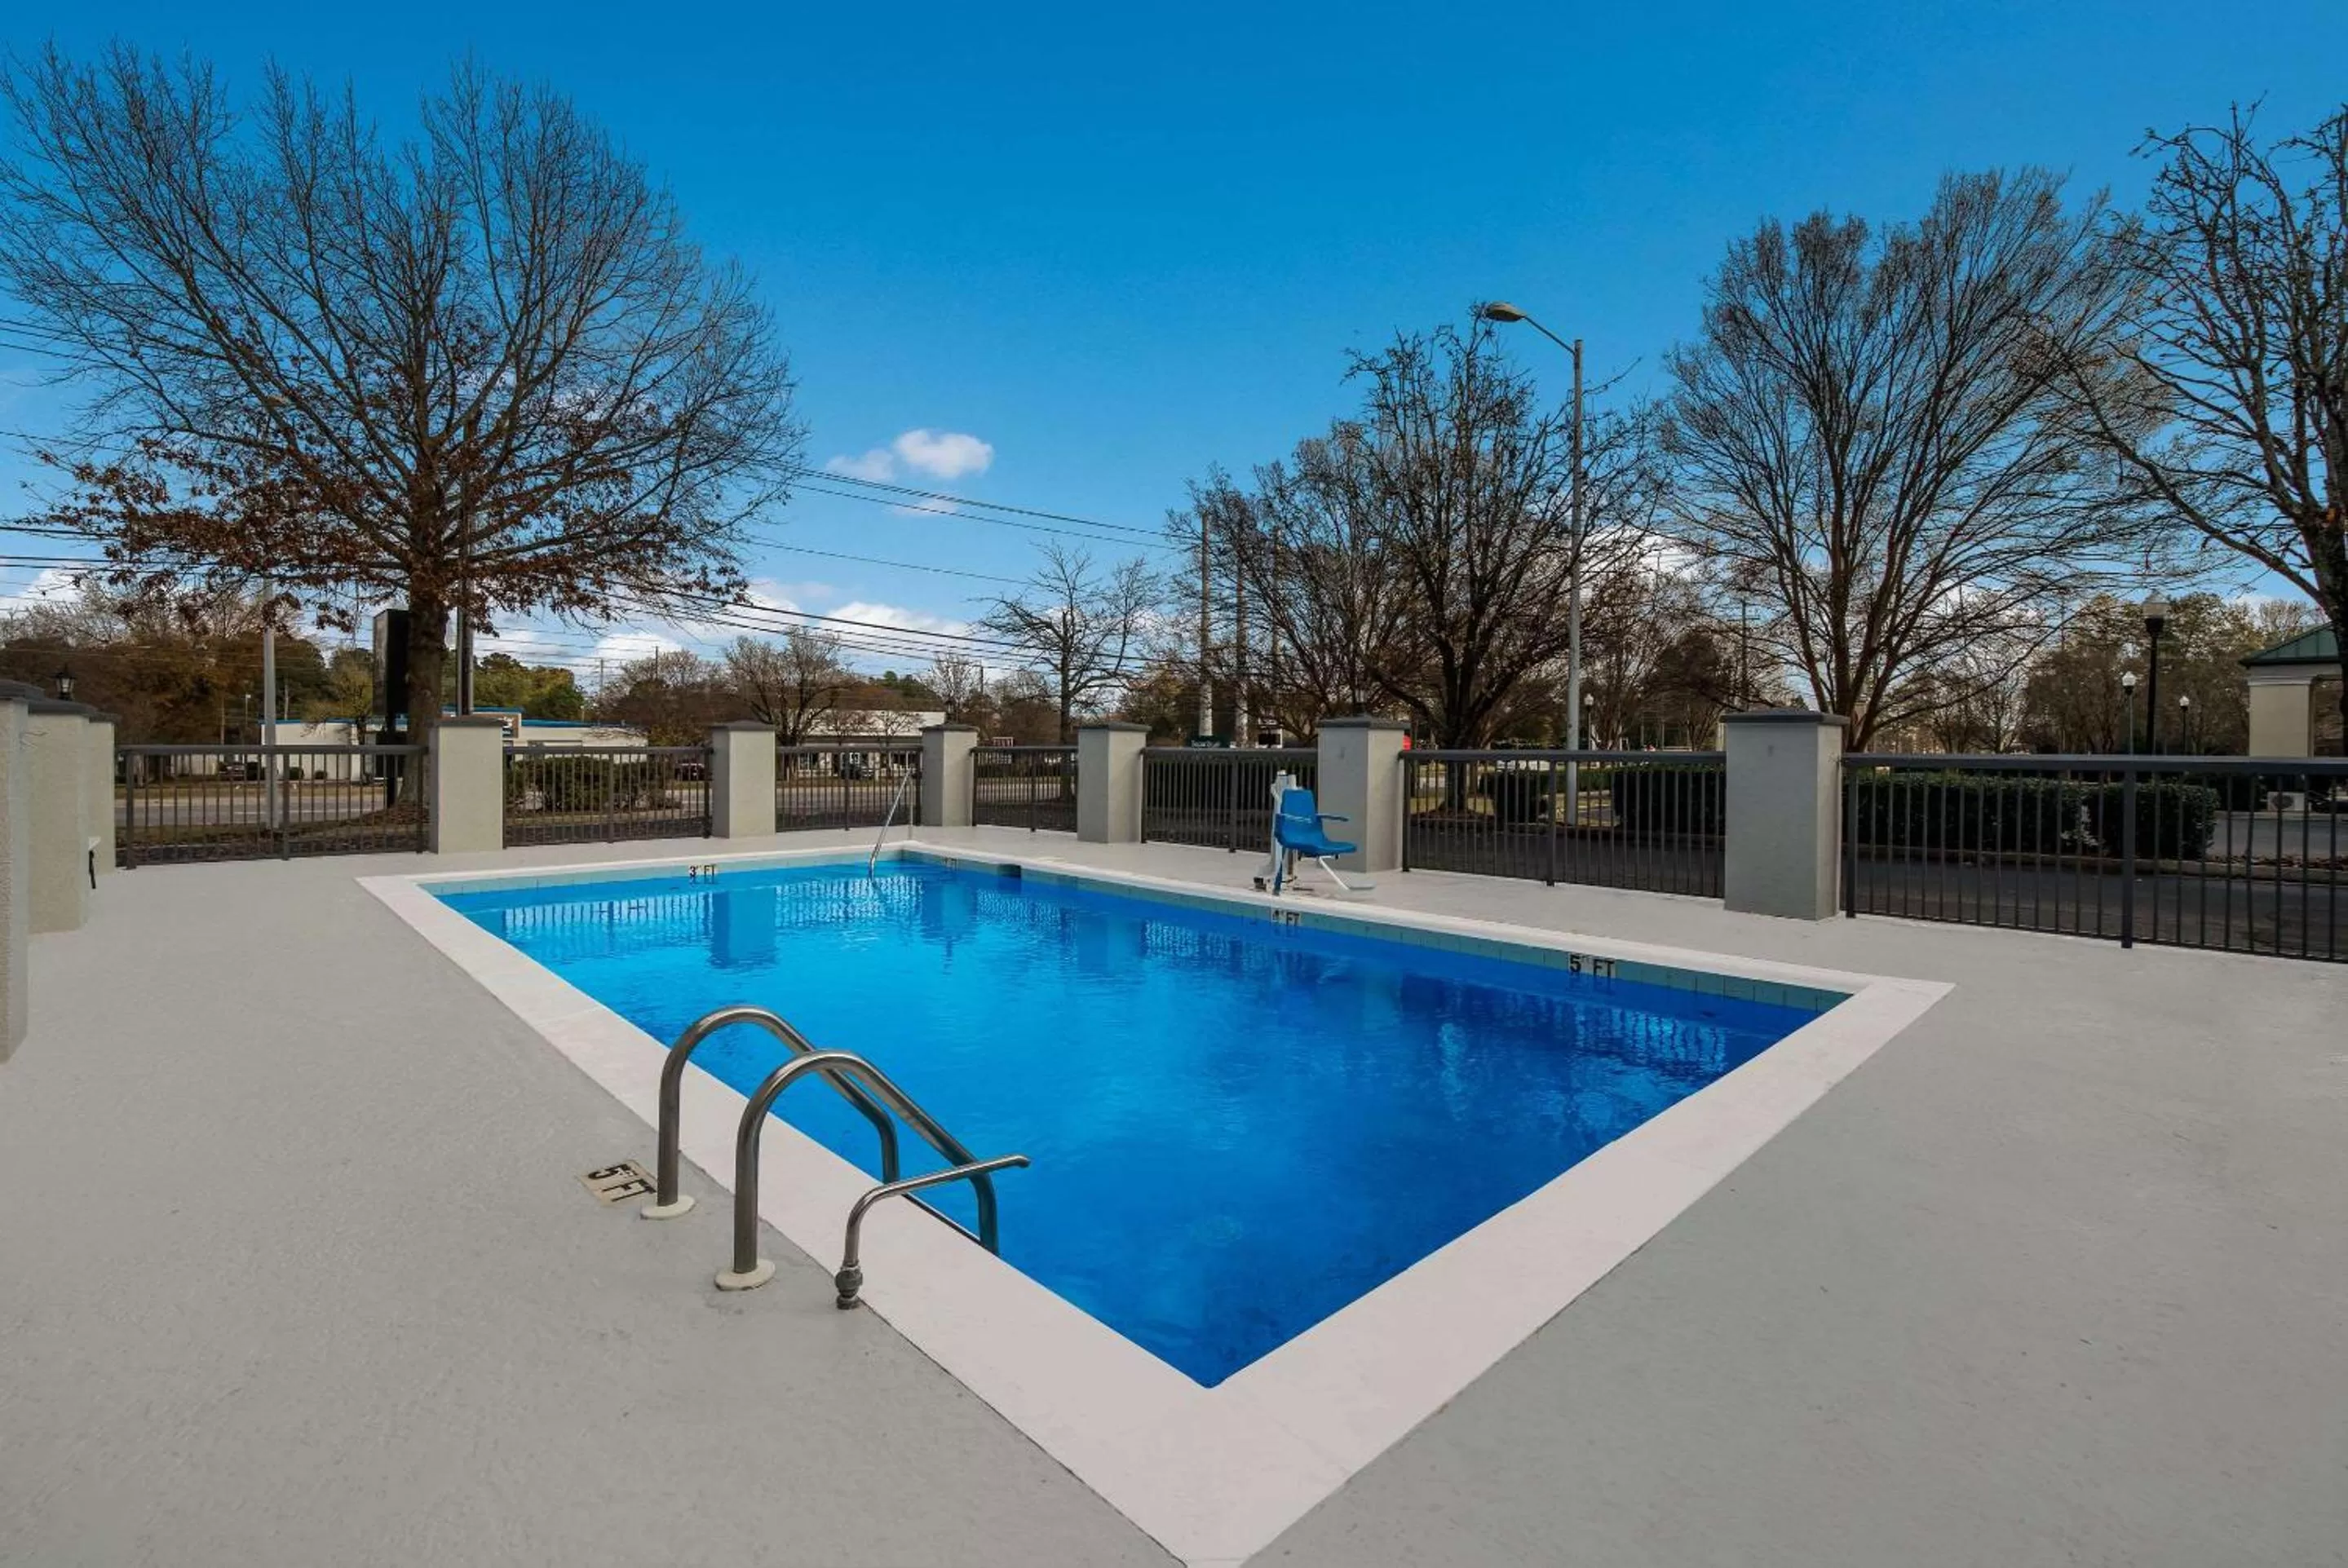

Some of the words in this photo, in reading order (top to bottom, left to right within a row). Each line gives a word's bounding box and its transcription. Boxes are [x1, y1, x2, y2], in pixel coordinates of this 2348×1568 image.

[704, 864, 716, 876] FT
[1286, 912, 1299, 926] FT
[1593, 958, 1615, 978] FT
[602, 1179, 656, 1202] FT
